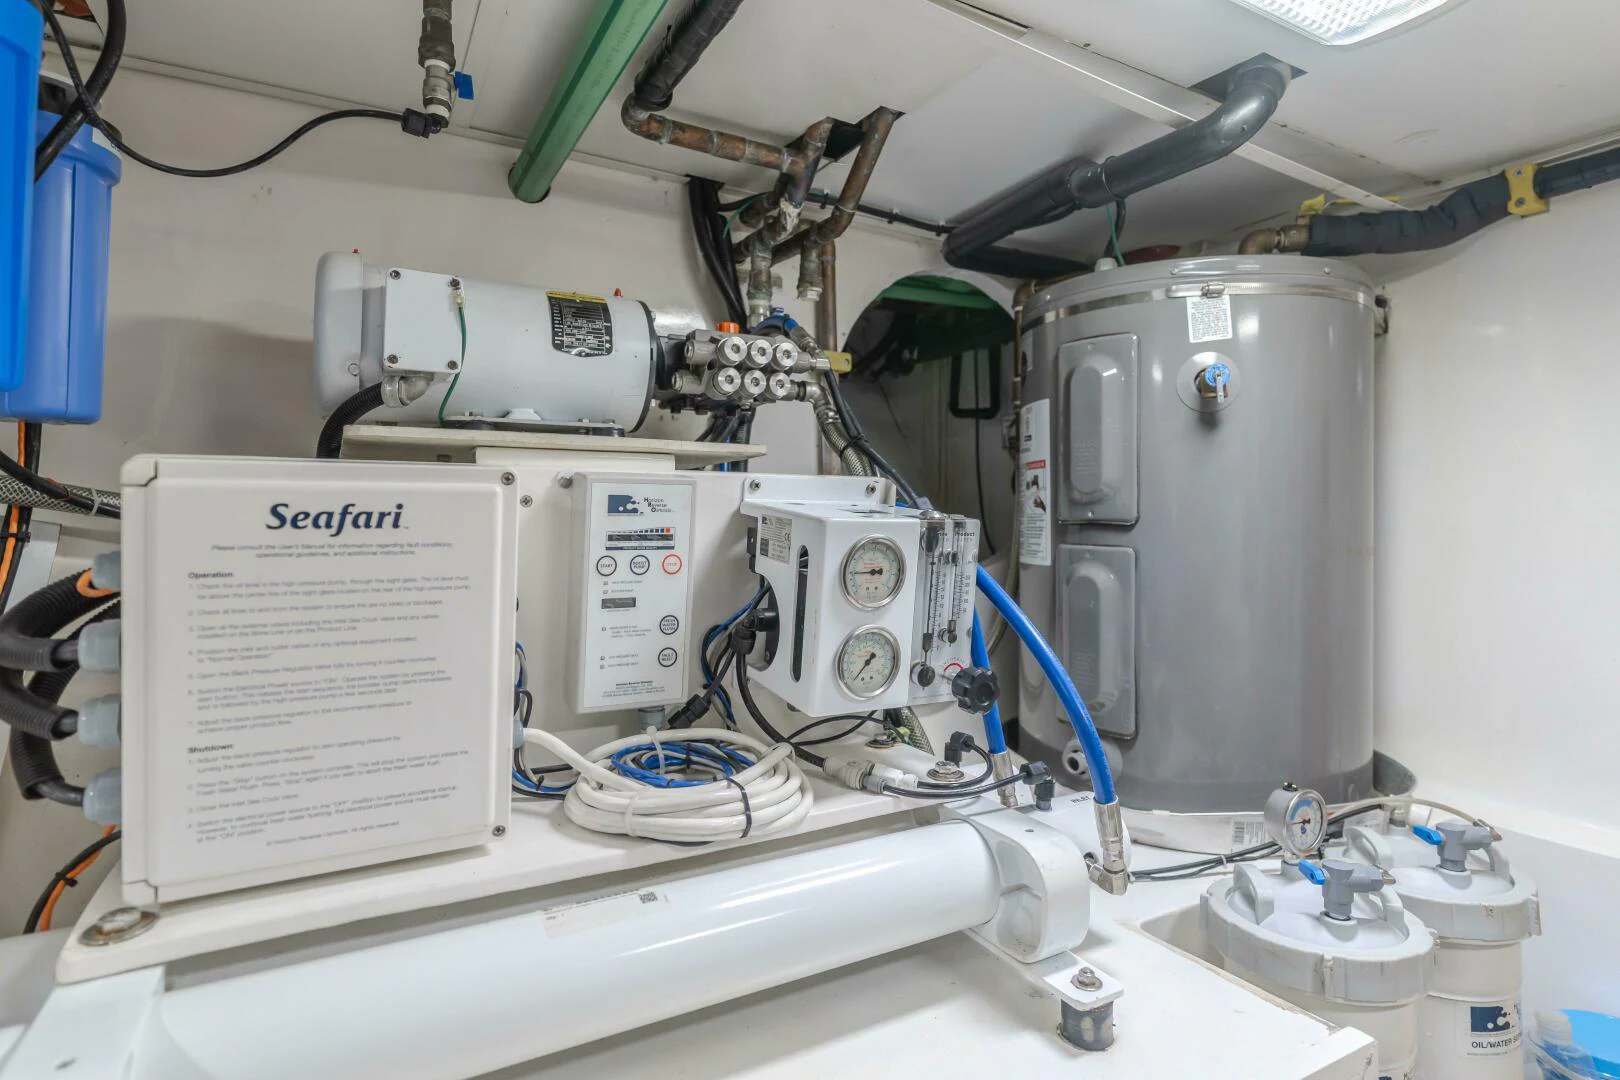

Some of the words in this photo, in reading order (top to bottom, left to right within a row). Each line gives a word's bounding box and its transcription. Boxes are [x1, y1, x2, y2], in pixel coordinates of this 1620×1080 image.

[265, 503, 404, 537] Seafari
[187, 743, 233, 753] Shutdown
[1472, 1038, 1512, 1049] OIL/WATER
